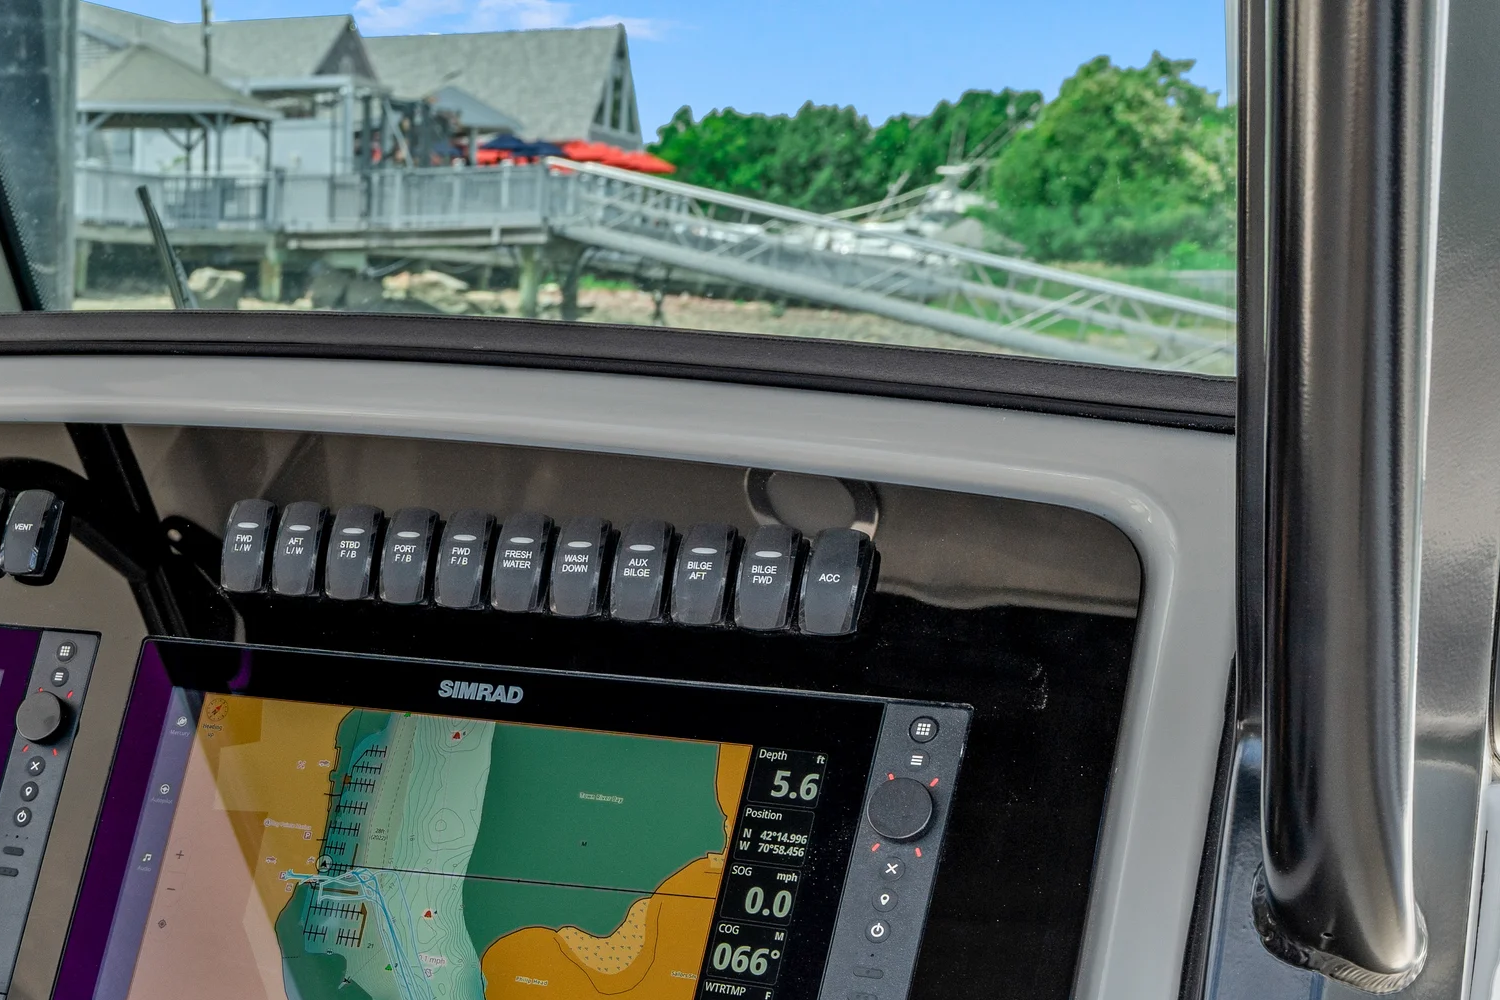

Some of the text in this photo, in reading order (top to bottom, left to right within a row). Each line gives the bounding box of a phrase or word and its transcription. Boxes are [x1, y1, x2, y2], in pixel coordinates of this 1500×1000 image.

[14, 523, 34, 531] VENT
[236, 534, 253, 542] FWD
[288, 538, 304, 546] AFT
[340, 540, 360, 549] STBD
[394, 544, 416, 554] PORT
[452, 547, 470, 556] FWD
[504, 550, 532, 559] FRESH
[564, 554, 588, 563] WASH
[628, 558, 648, 567] AUX
[503, 560, 531, 569] WATER
[562, 564, 588, 573] DOWN
[688, 562, 713, 571] BILGE
[624, 568, 650, 577] BILGE
[752, 565, 778, 574] BILGE
[689, 571, 708, 580] AFT
[752, 575, 773, 584] FWD
[819, 573, 840, 582] ACC
[438, 680, 524, 704] SIMRAD
[759, 749, 826, 764] Depth ft
[770, 770, 820, 800] 5.6
[745, 808, 782, 820] Position
[742, 828, 808, 844] N 42°14.996
[739, 841, 805, 857] W 70°58.456
[732, 866, 798, 883] SOG mph
[745, 886, 792, 918] 0.0
[718, 924, 784, 941] COG M
[429, 956, 446, 966] mph
[713, 942, 780, 976] 066°
[705, 982, 772, 1000] WTRTMP F
